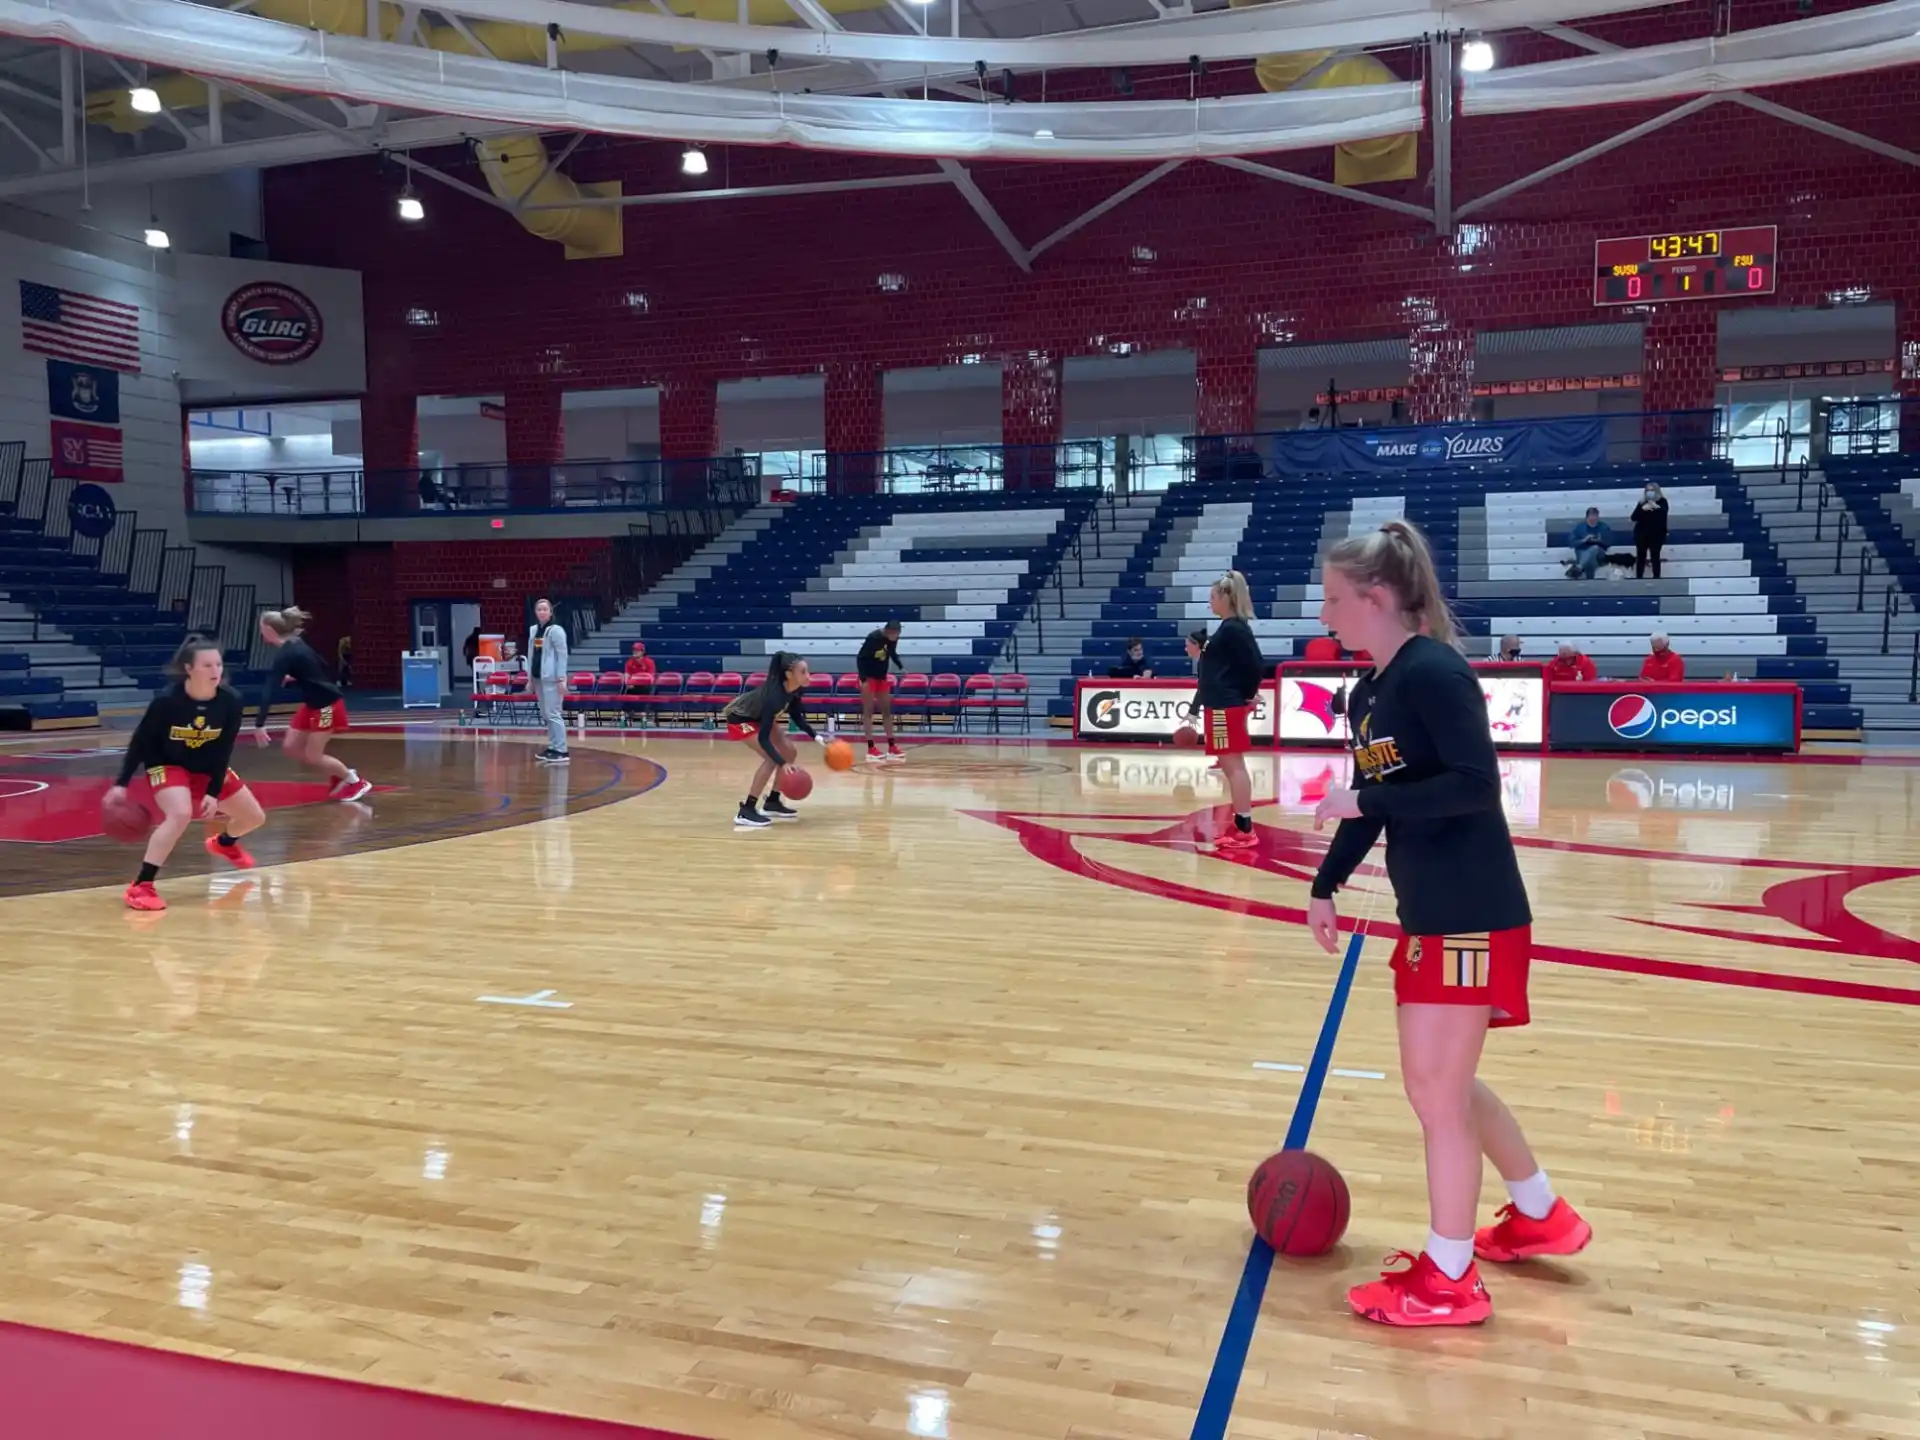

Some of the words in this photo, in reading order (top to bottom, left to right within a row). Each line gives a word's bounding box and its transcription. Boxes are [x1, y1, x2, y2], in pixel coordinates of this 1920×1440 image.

[1652, 233, 1718, 257] 43:47
[1734, 255, 1753, 267] FSU
[1628, 276, 1641, 298] 0
[1683, 275, 1690, 291] 1
[1748, 267, 1762, 289] 0
[242, 318, 307, 337] GLIAC
[1376, 444, 1418, 457] MAKE
[1443, 432, 1504, 460] YOURS
[1124, 700, 1266, 720] GATOE
[1661, 706, 1737, 729] pepsi
